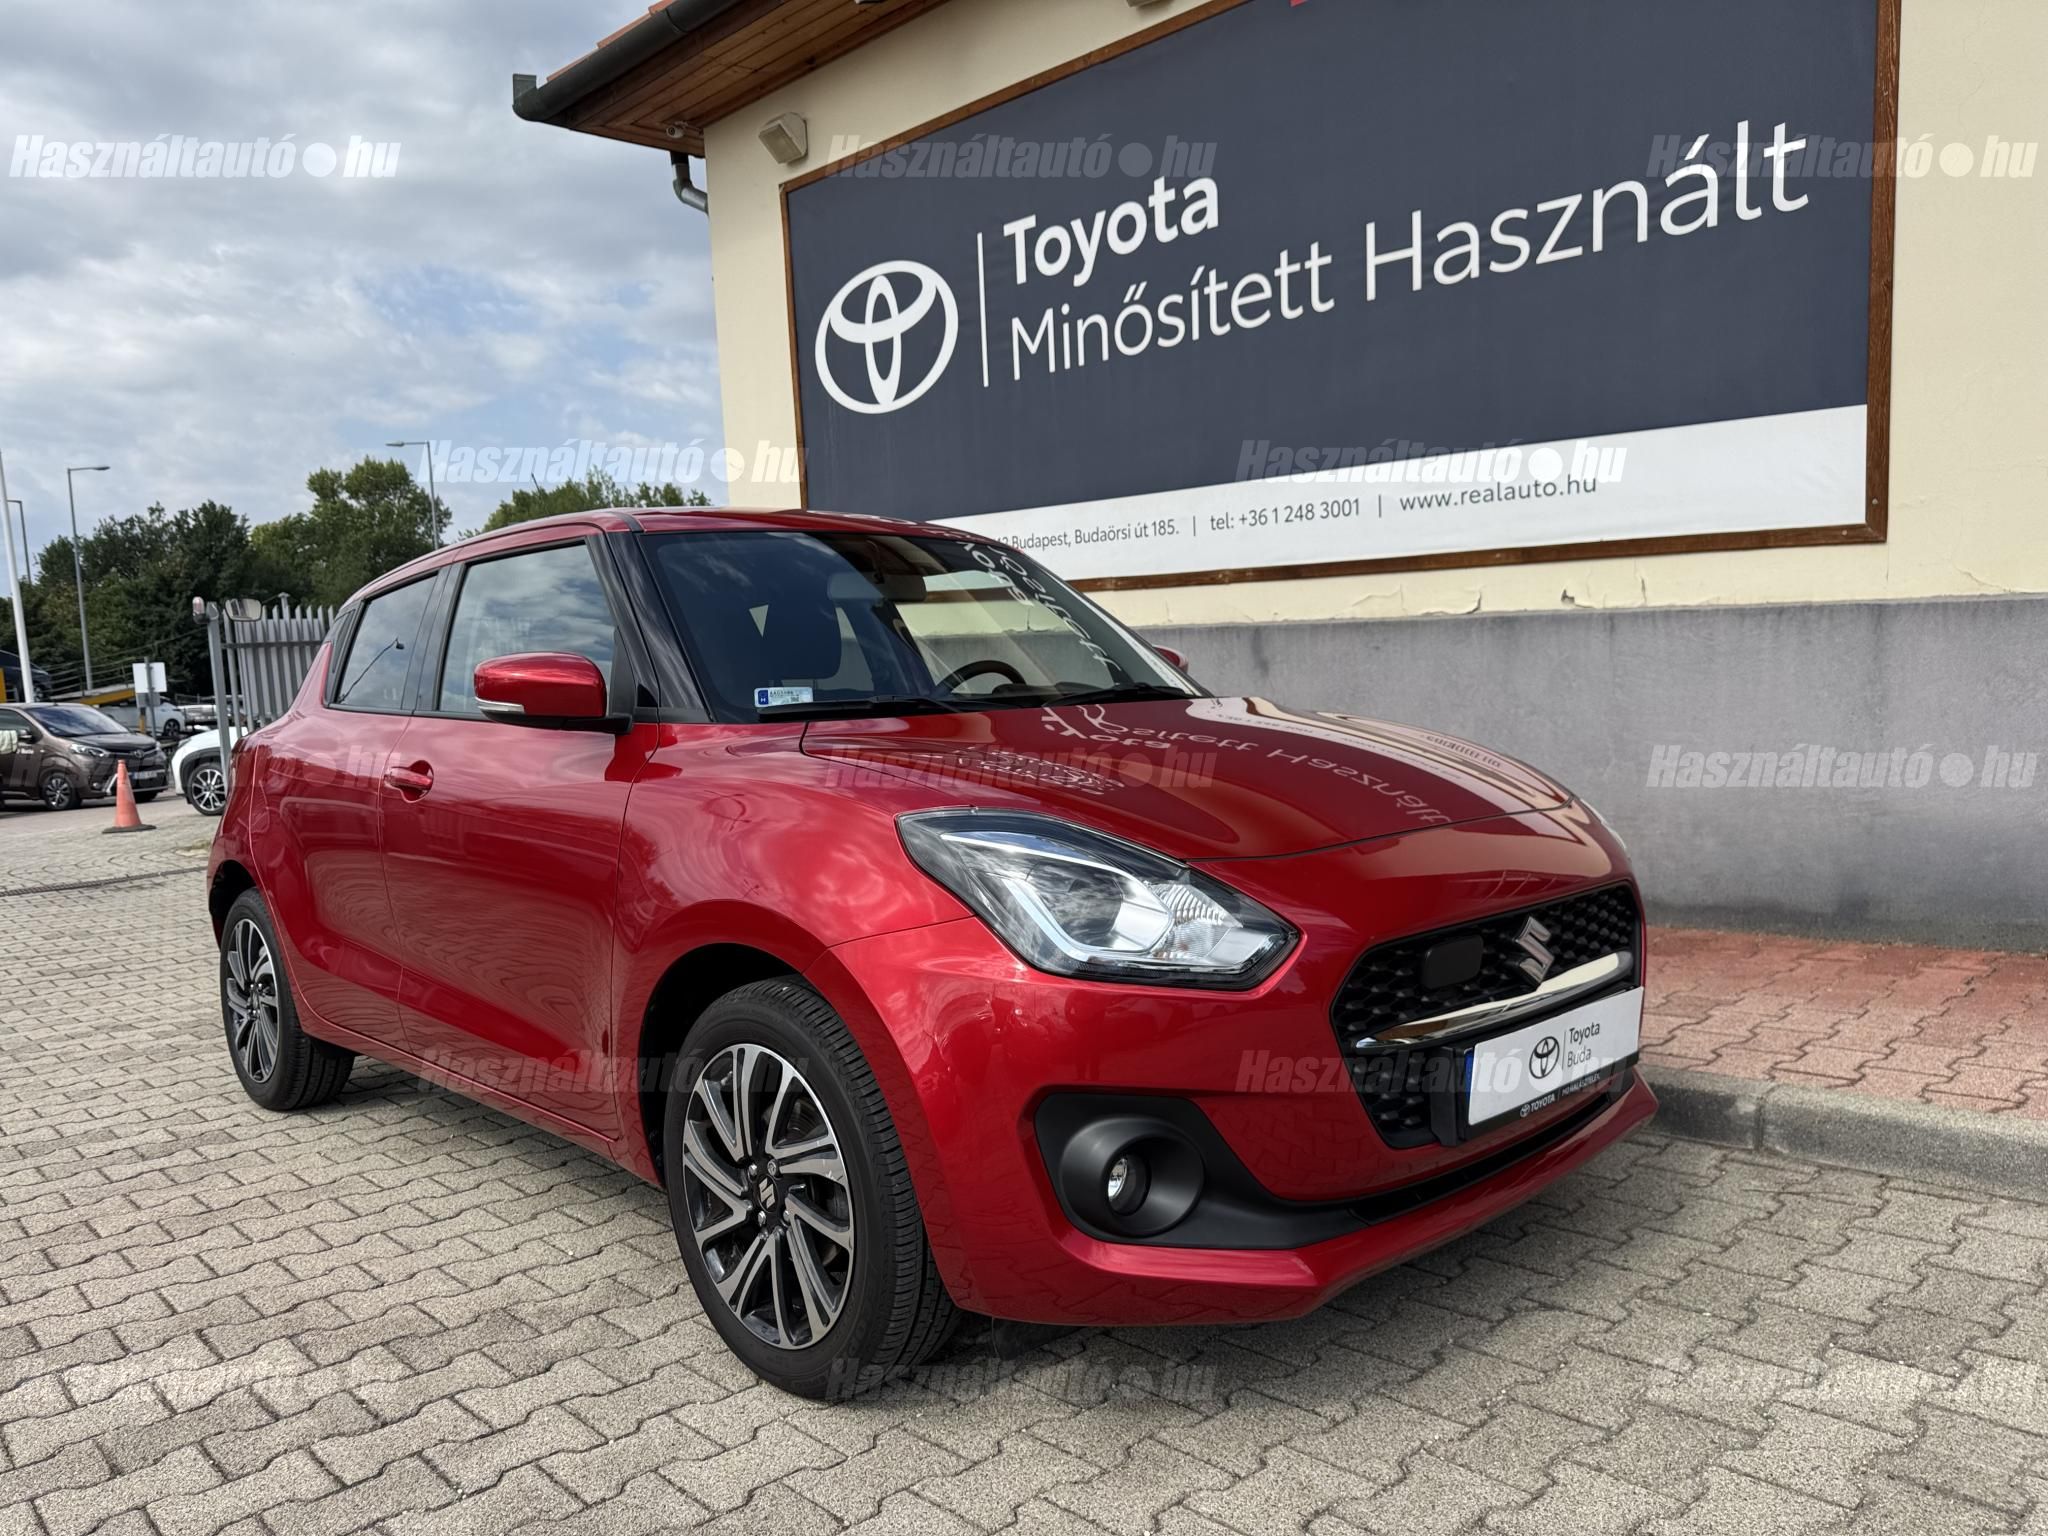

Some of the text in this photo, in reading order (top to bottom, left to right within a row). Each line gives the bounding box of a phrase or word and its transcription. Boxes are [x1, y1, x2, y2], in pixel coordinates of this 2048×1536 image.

[1003, 176, 1220, 287] Toyota
[1010, 120, 1809, 381] Minősített Használt
[1012, 531, 1072, 551] Budapest,
[1075, 523, 1132, 544] Budaörsi
[1134, 521, 1149, 539] út
[1151, 518, 1180, 537] 185.
[1210, 511, 1235, 531] tel:
[1239, 508, 1268, 527] +36
[1271, 507, 1279, 524] 1
[1284, 503, 1315, 523] 248
[1319, 498, 1360, 519] 3001
[1400, 474, 1598, 512] www.realauto.hu
[1567, 1045, 1592, 1068] Buda
[1569, 1021, 1600, 1046] Toyota
[1531, 1092, 1556, 1112] TOYOTA
